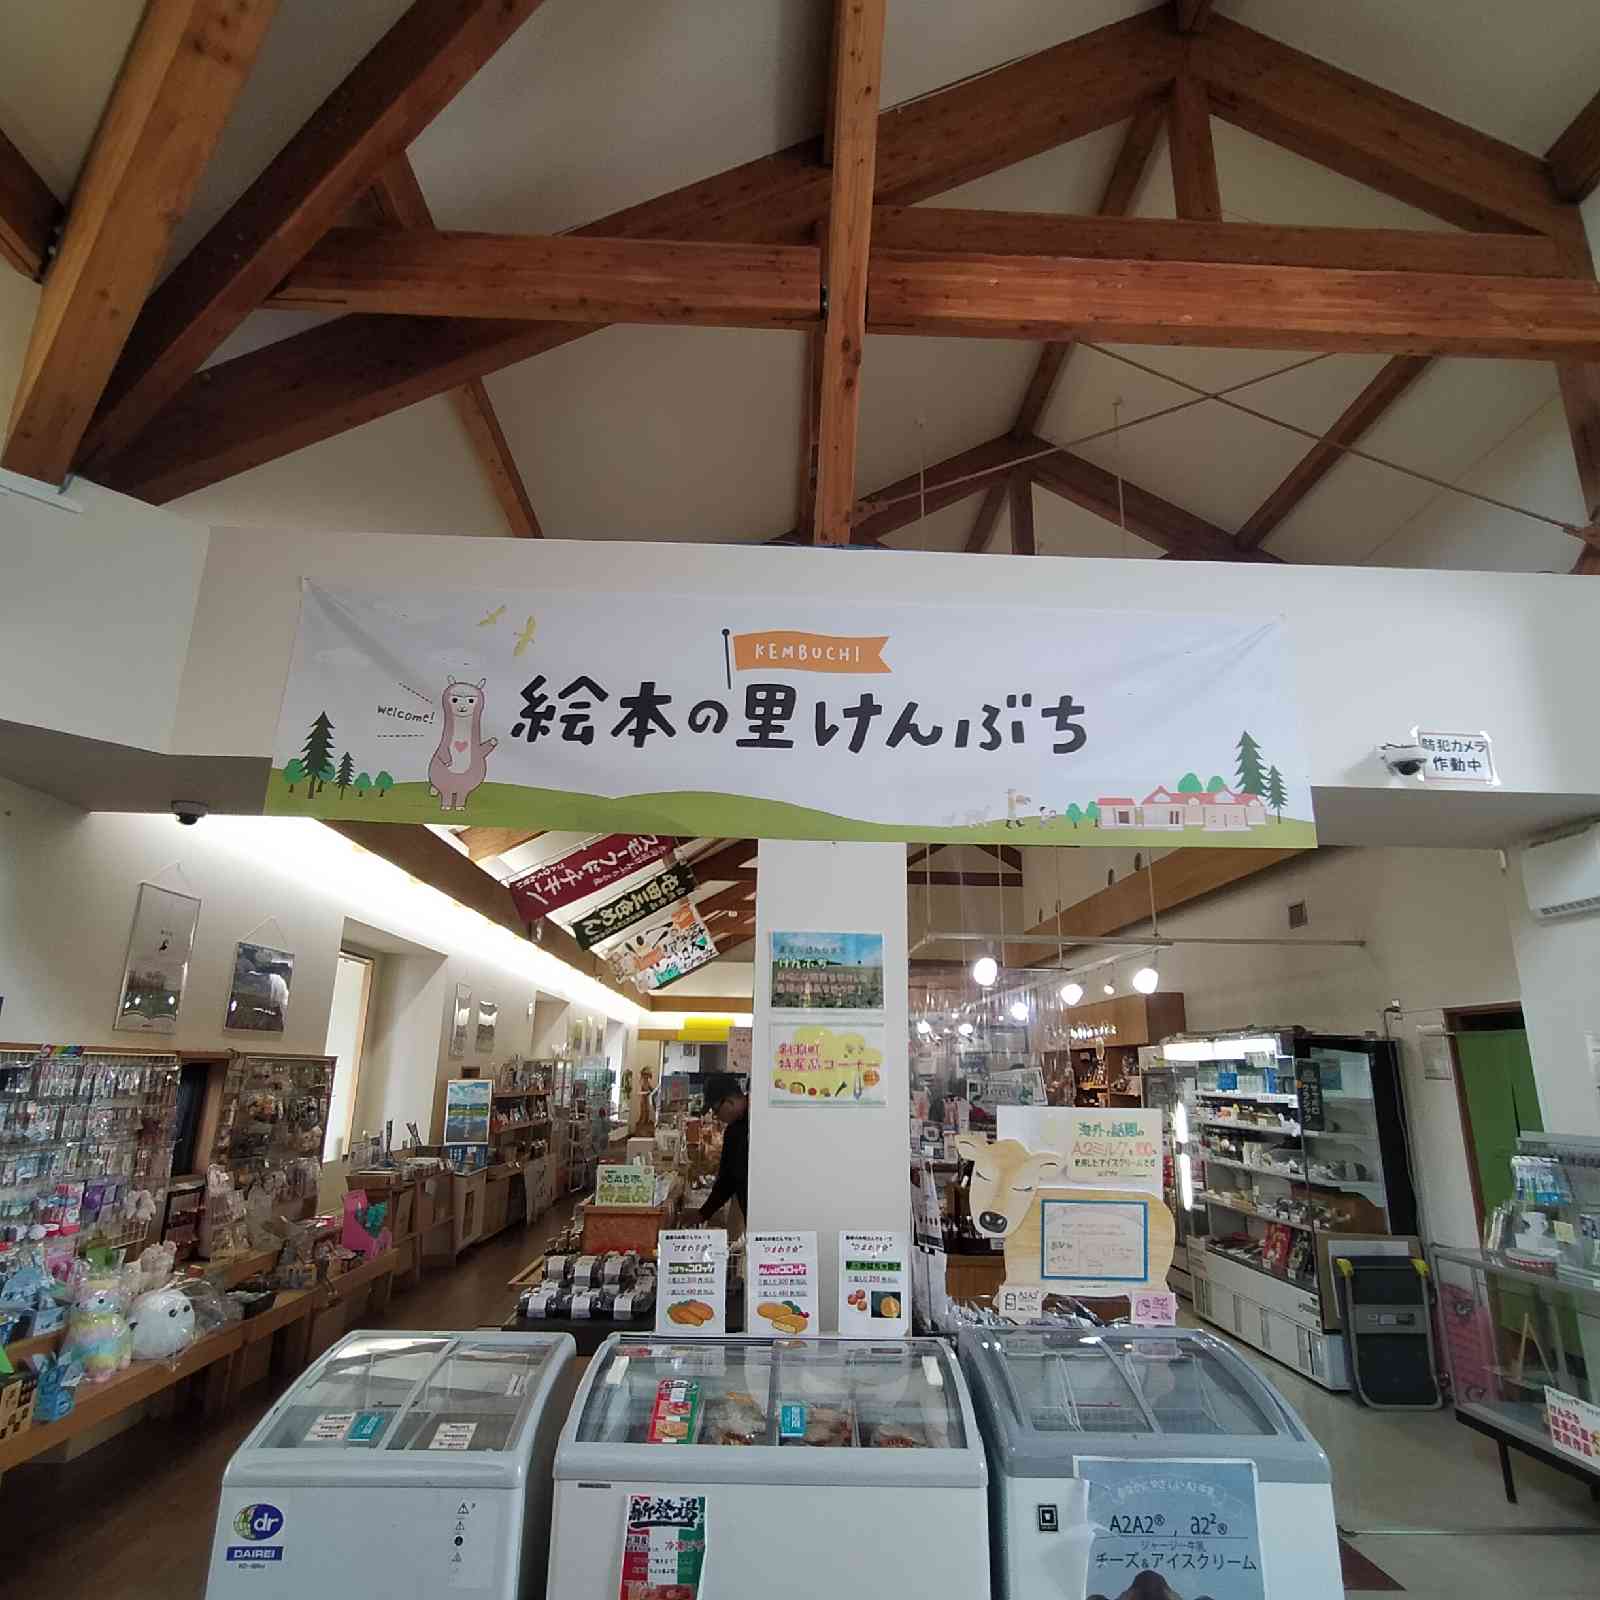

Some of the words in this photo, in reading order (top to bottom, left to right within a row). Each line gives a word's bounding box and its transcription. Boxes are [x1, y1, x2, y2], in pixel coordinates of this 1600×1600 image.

[755, 643, 861, 662] KEMBUCHI
[377, 704, 436, 725] welcome!
[511, 674, 1087, 754] 絵本の里けんぶち
[1432, 756, 1482, 772] 作動中
[628, 1497, 699, 1523] 新登場
[253, 1512, 280, 1532] dr
[233, 1549, 276, 1558] DAIREI
